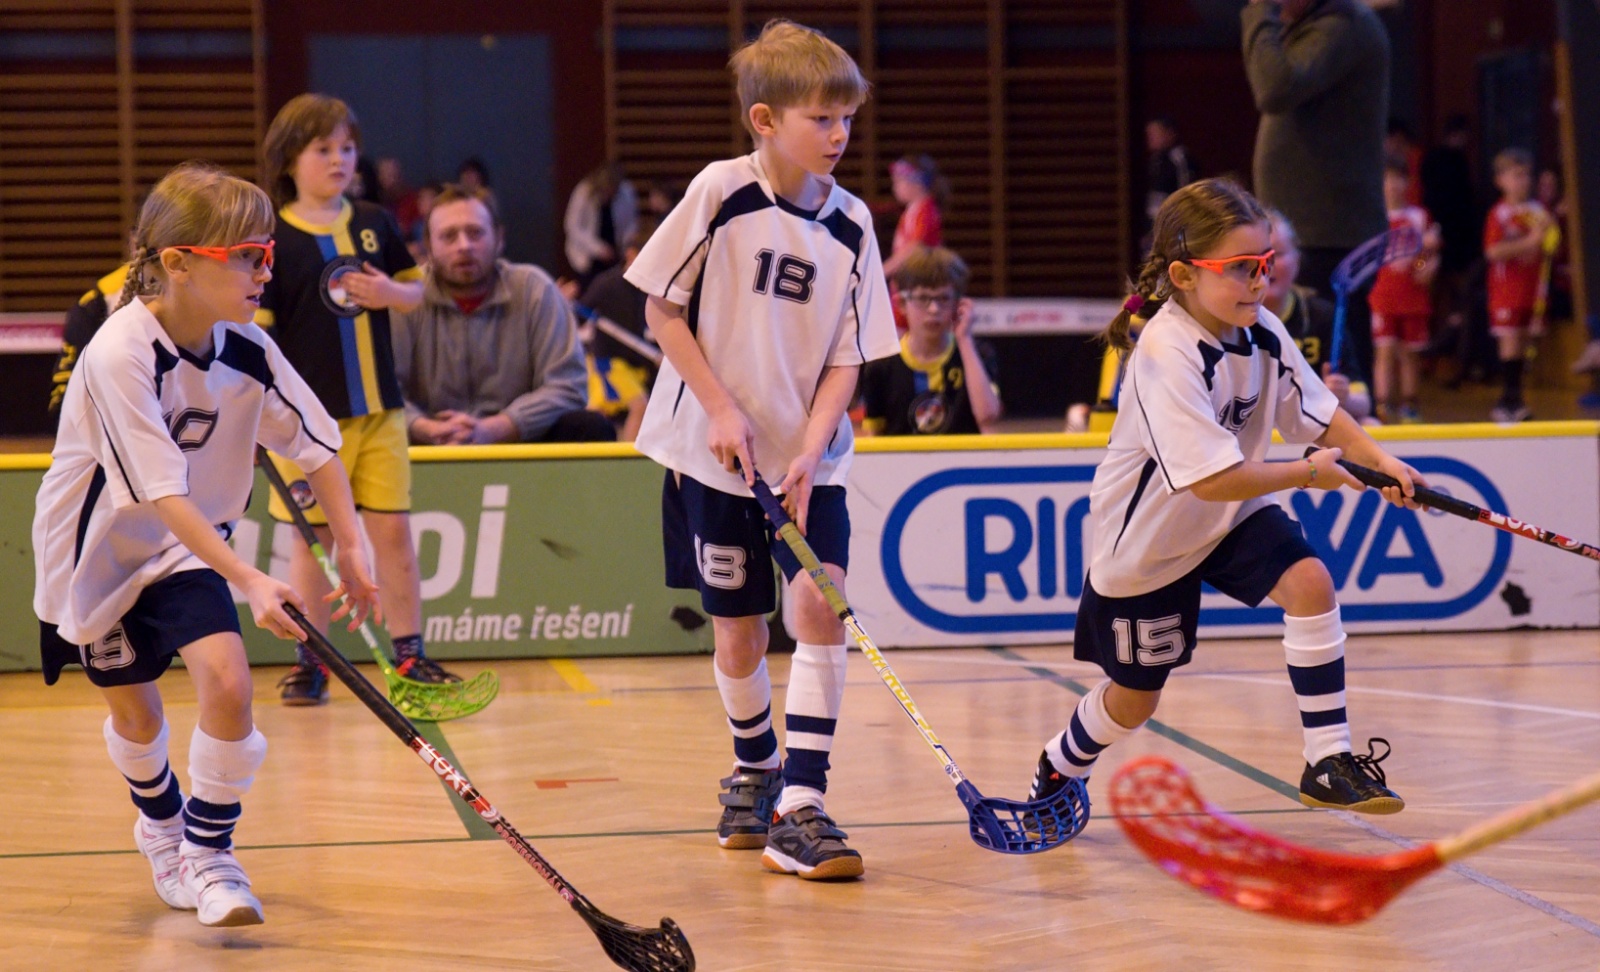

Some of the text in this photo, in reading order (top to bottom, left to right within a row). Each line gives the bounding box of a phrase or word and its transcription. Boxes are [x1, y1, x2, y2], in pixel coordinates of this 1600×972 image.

[360, 228, 378, 253] 8
[752, 247, 818, 304] 18
[424, 603, 635, 643] máme řešení
[1111, 613, 1187, 667] 15
